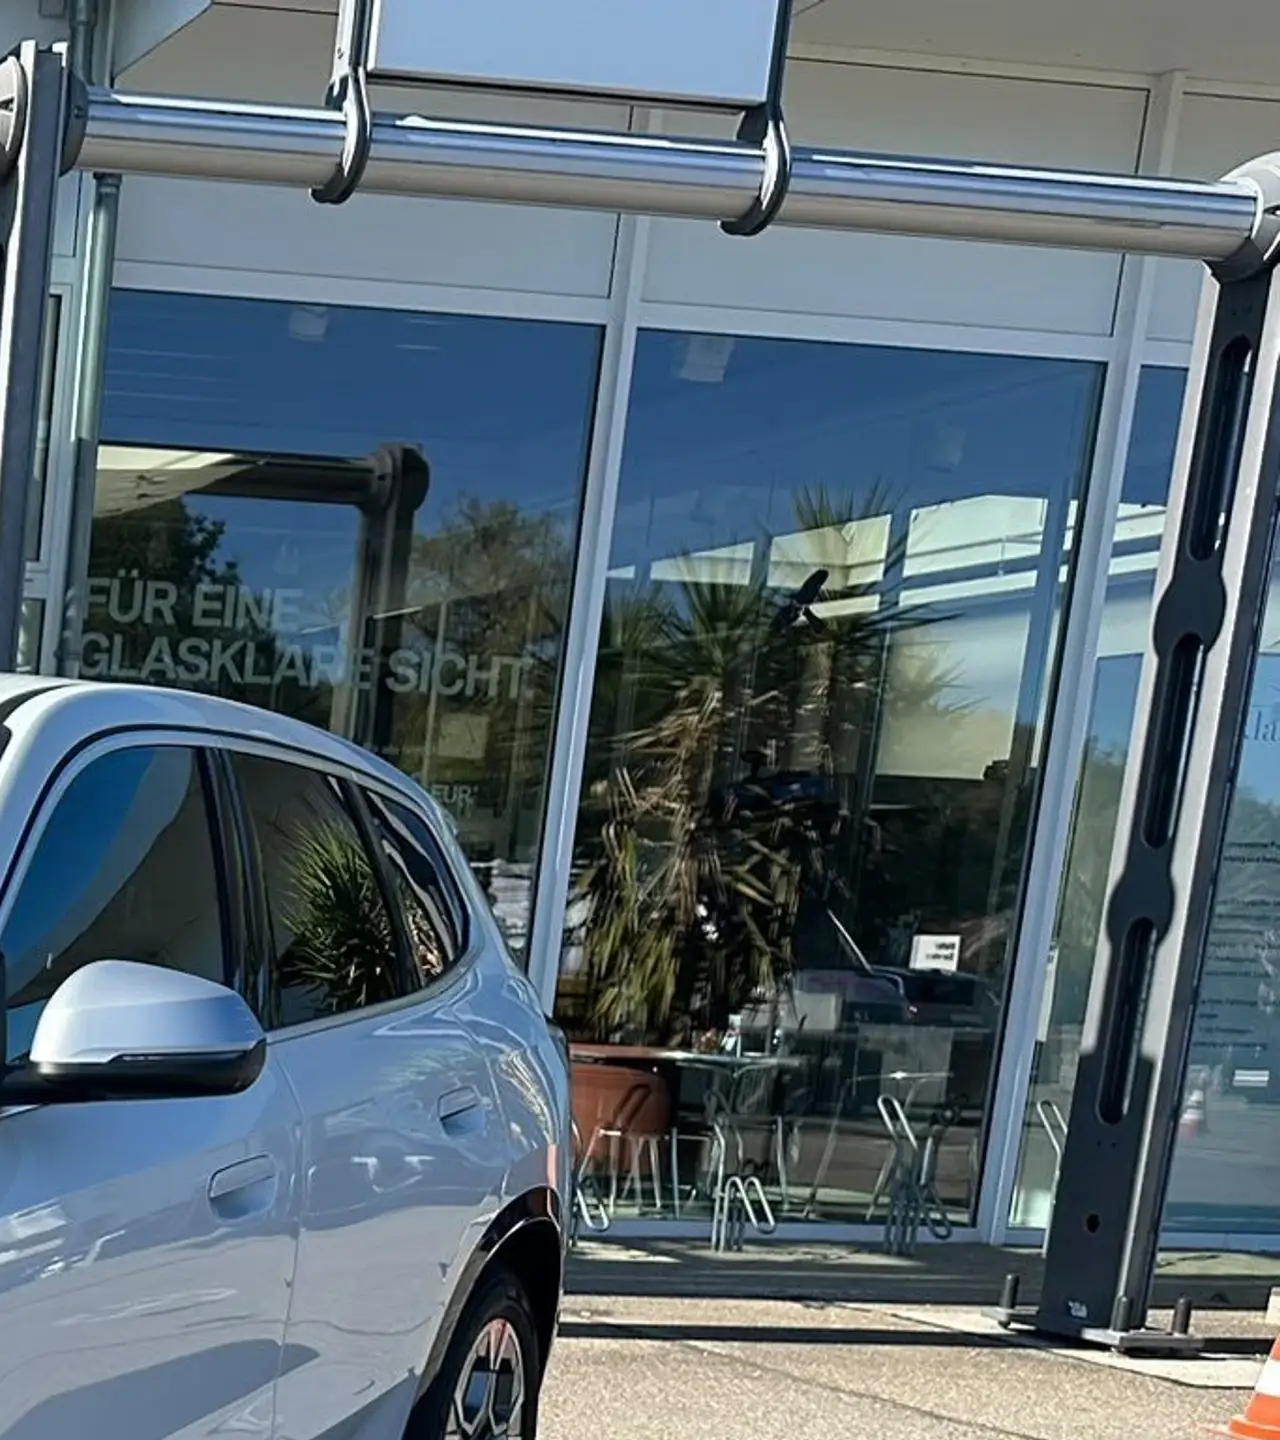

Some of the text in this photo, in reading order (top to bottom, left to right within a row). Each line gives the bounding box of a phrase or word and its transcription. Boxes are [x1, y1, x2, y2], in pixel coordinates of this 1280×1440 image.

[83, 569, 303, 632] FÜR EINE
[80, 633, 375, 690] GLASKLARE
